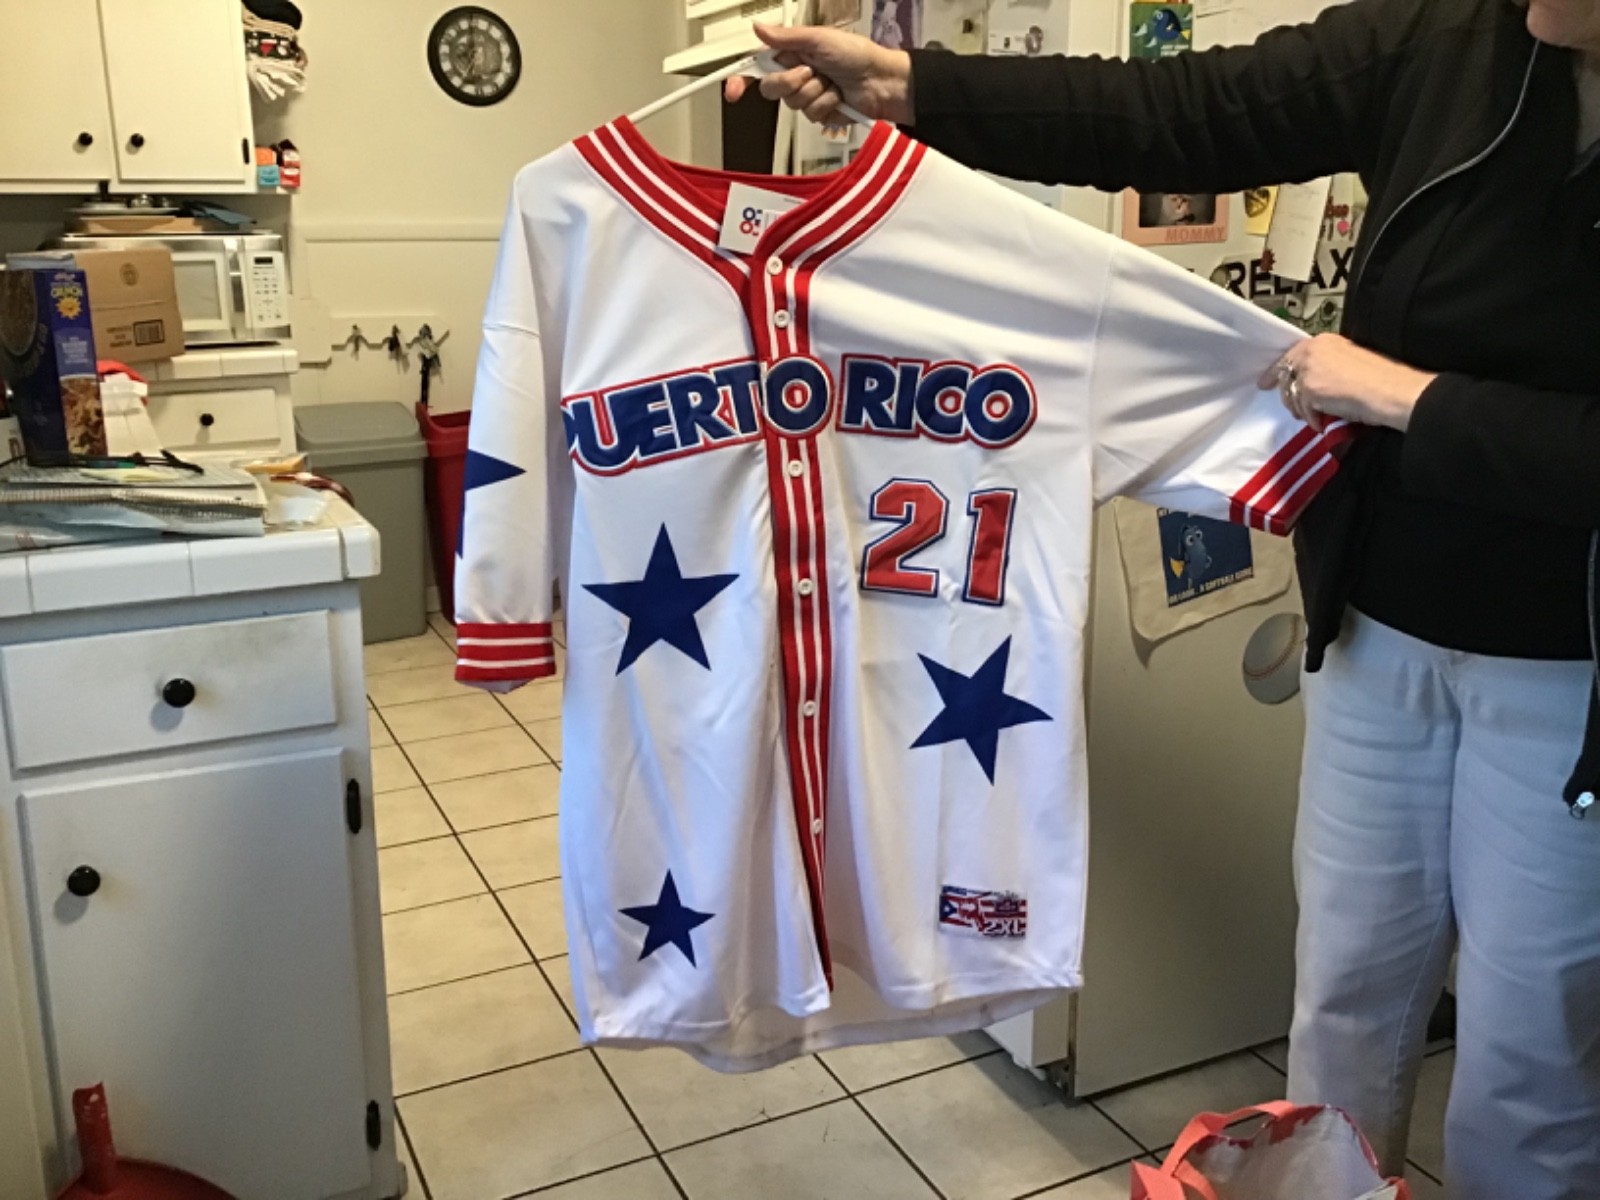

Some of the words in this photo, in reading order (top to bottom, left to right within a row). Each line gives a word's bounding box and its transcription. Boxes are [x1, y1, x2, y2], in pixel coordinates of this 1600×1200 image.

[1165, 226, 1225, 242] MOMMY
[561, 355, 834, 476] UERTO
[836, 353, 1038, 449] RICO
[861, 477, 1018, 606] 21
[985, 919, 1025, 936] 2XL
